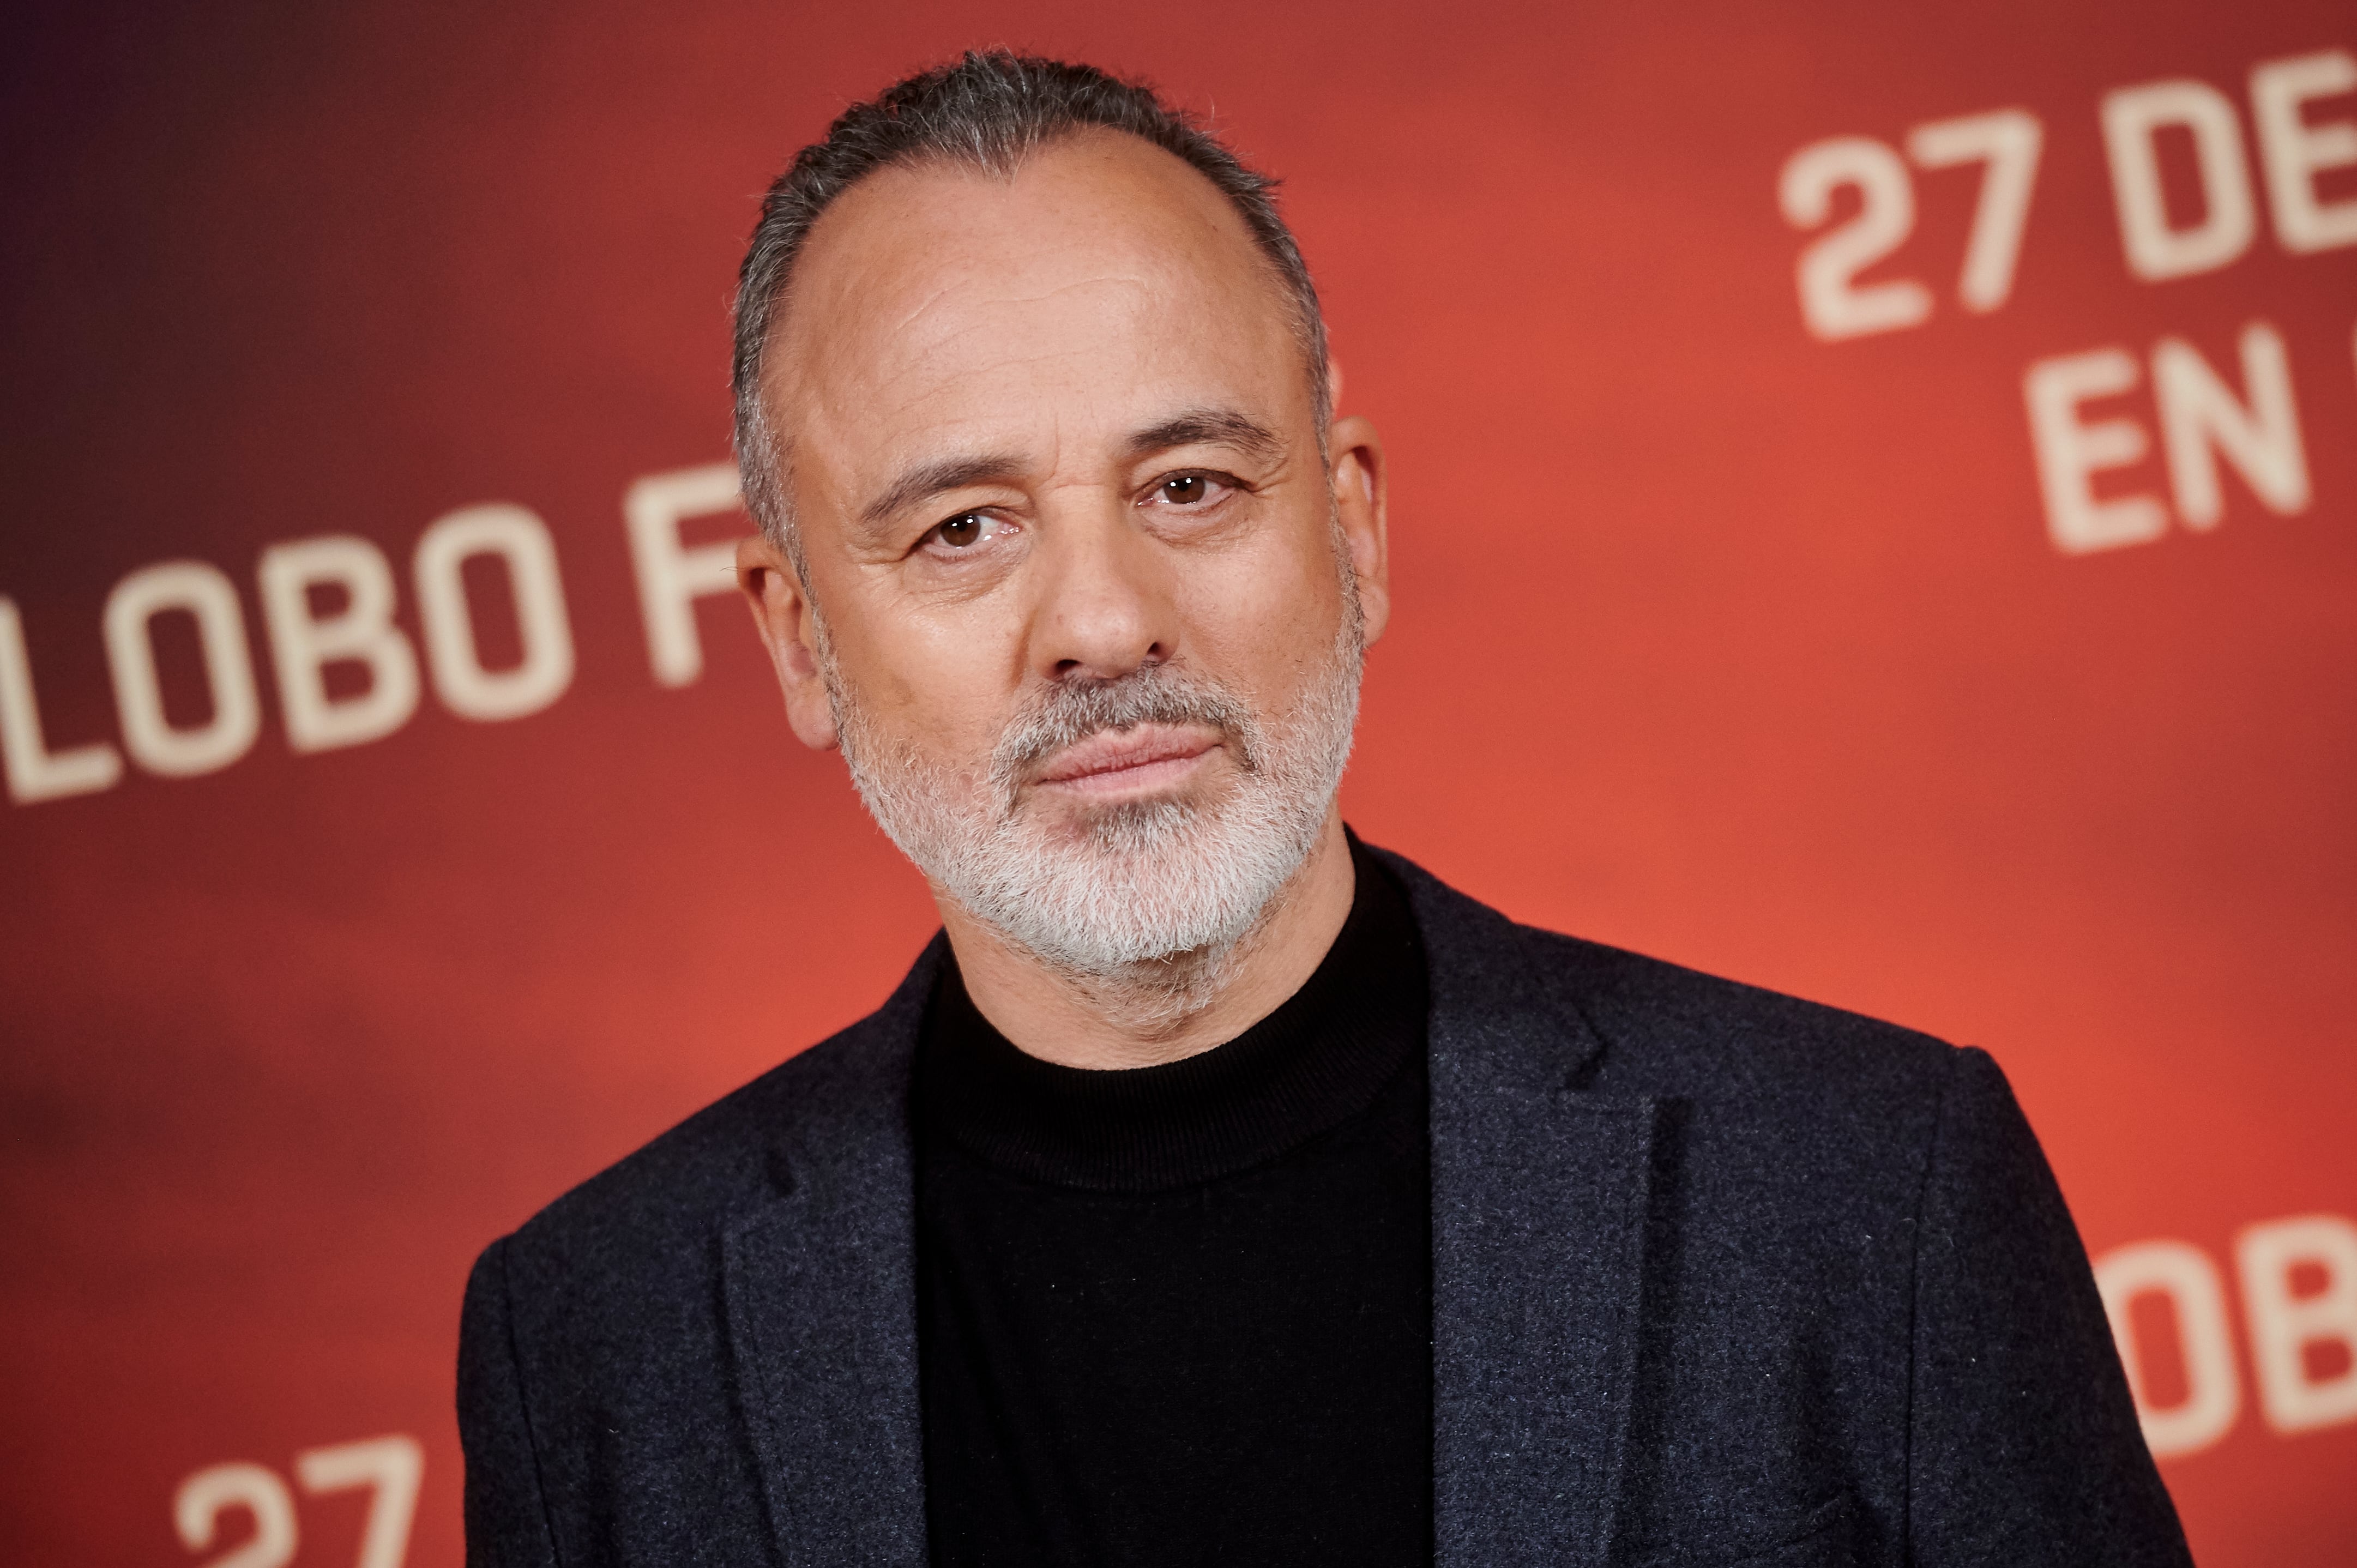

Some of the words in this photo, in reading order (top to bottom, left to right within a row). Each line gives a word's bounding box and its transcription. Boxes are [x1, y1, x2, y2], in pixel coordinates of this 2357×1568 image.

[1780, 108, 2042, 342] 27
[2102, 51, 2357, 283] DE
[2024, 319, 2311, 555] EN
[0, 504, 574, 803] LOBO
[174, 1435, 424, 1568] 27
